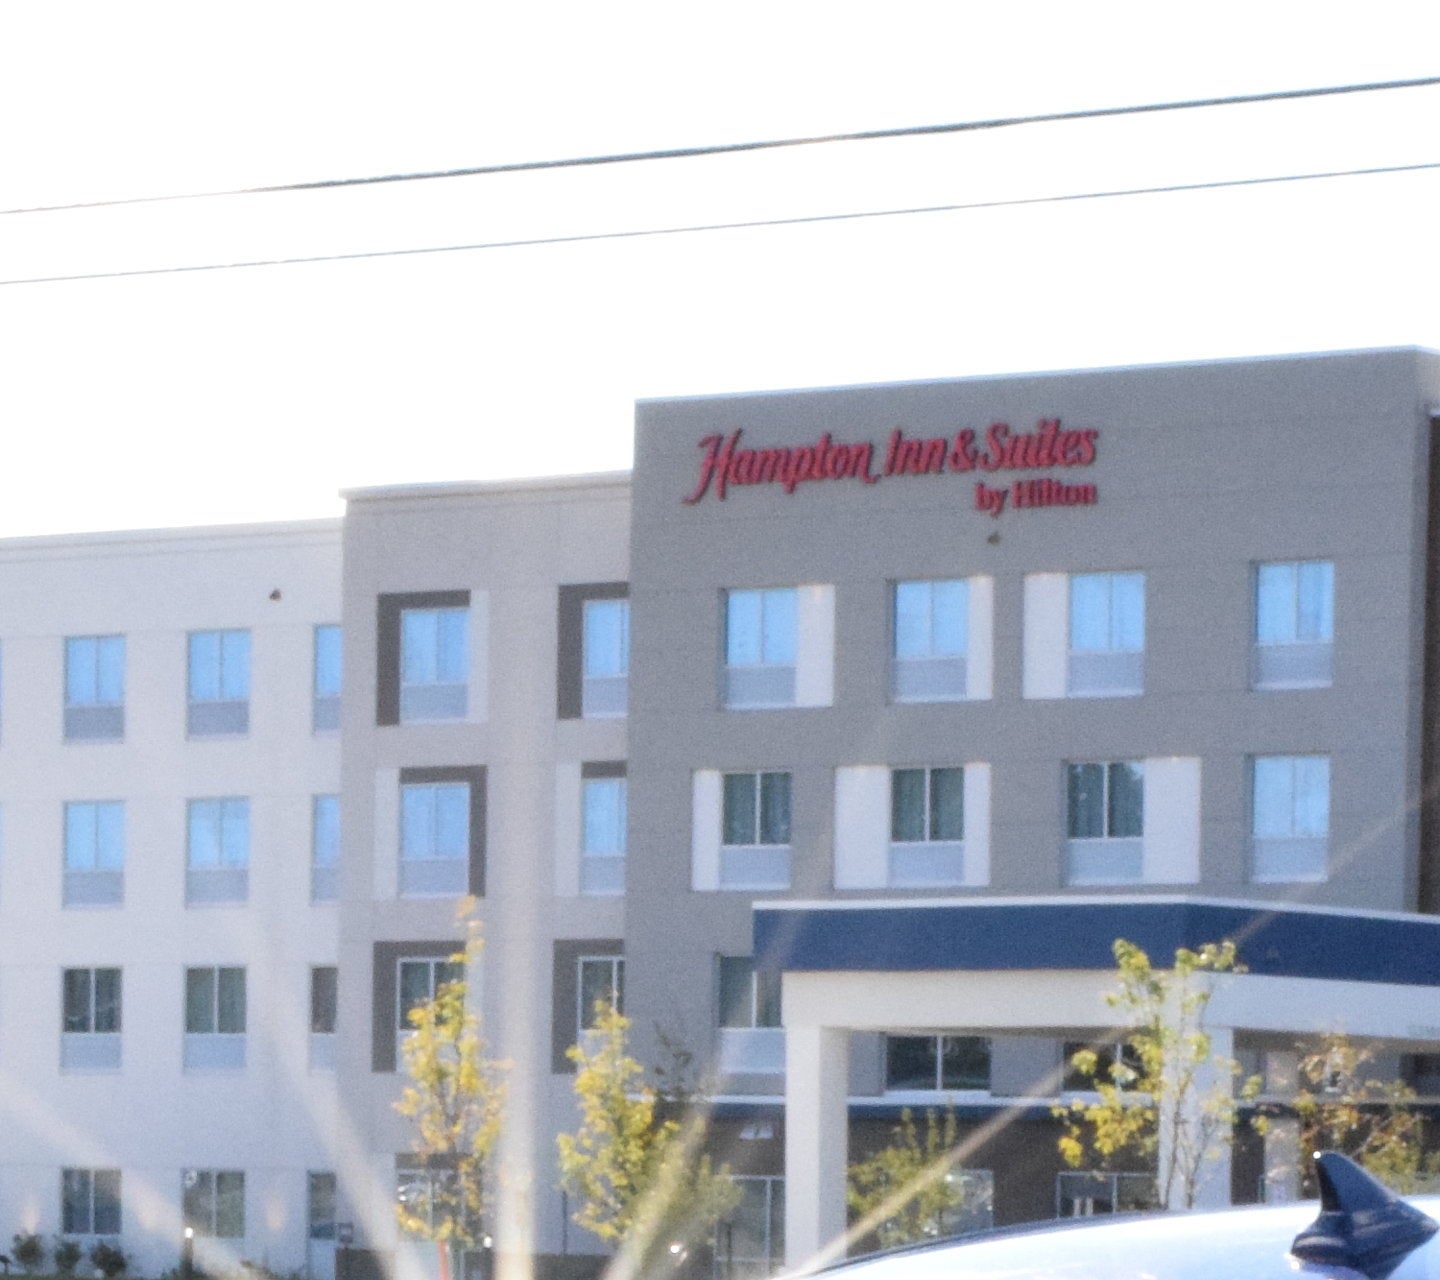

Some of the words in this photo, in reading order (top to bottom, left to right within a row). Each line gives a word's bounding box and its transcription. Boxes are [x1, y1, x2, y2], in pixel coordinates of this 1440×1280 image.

[681, 427, 881, 505] Hampton
[884, 428, 948, 477] Inn
[978, 418, 1098, 471] Suites
[975, 480, 1009, 517] by
[1012, 478, 1097, 508] Hilton
